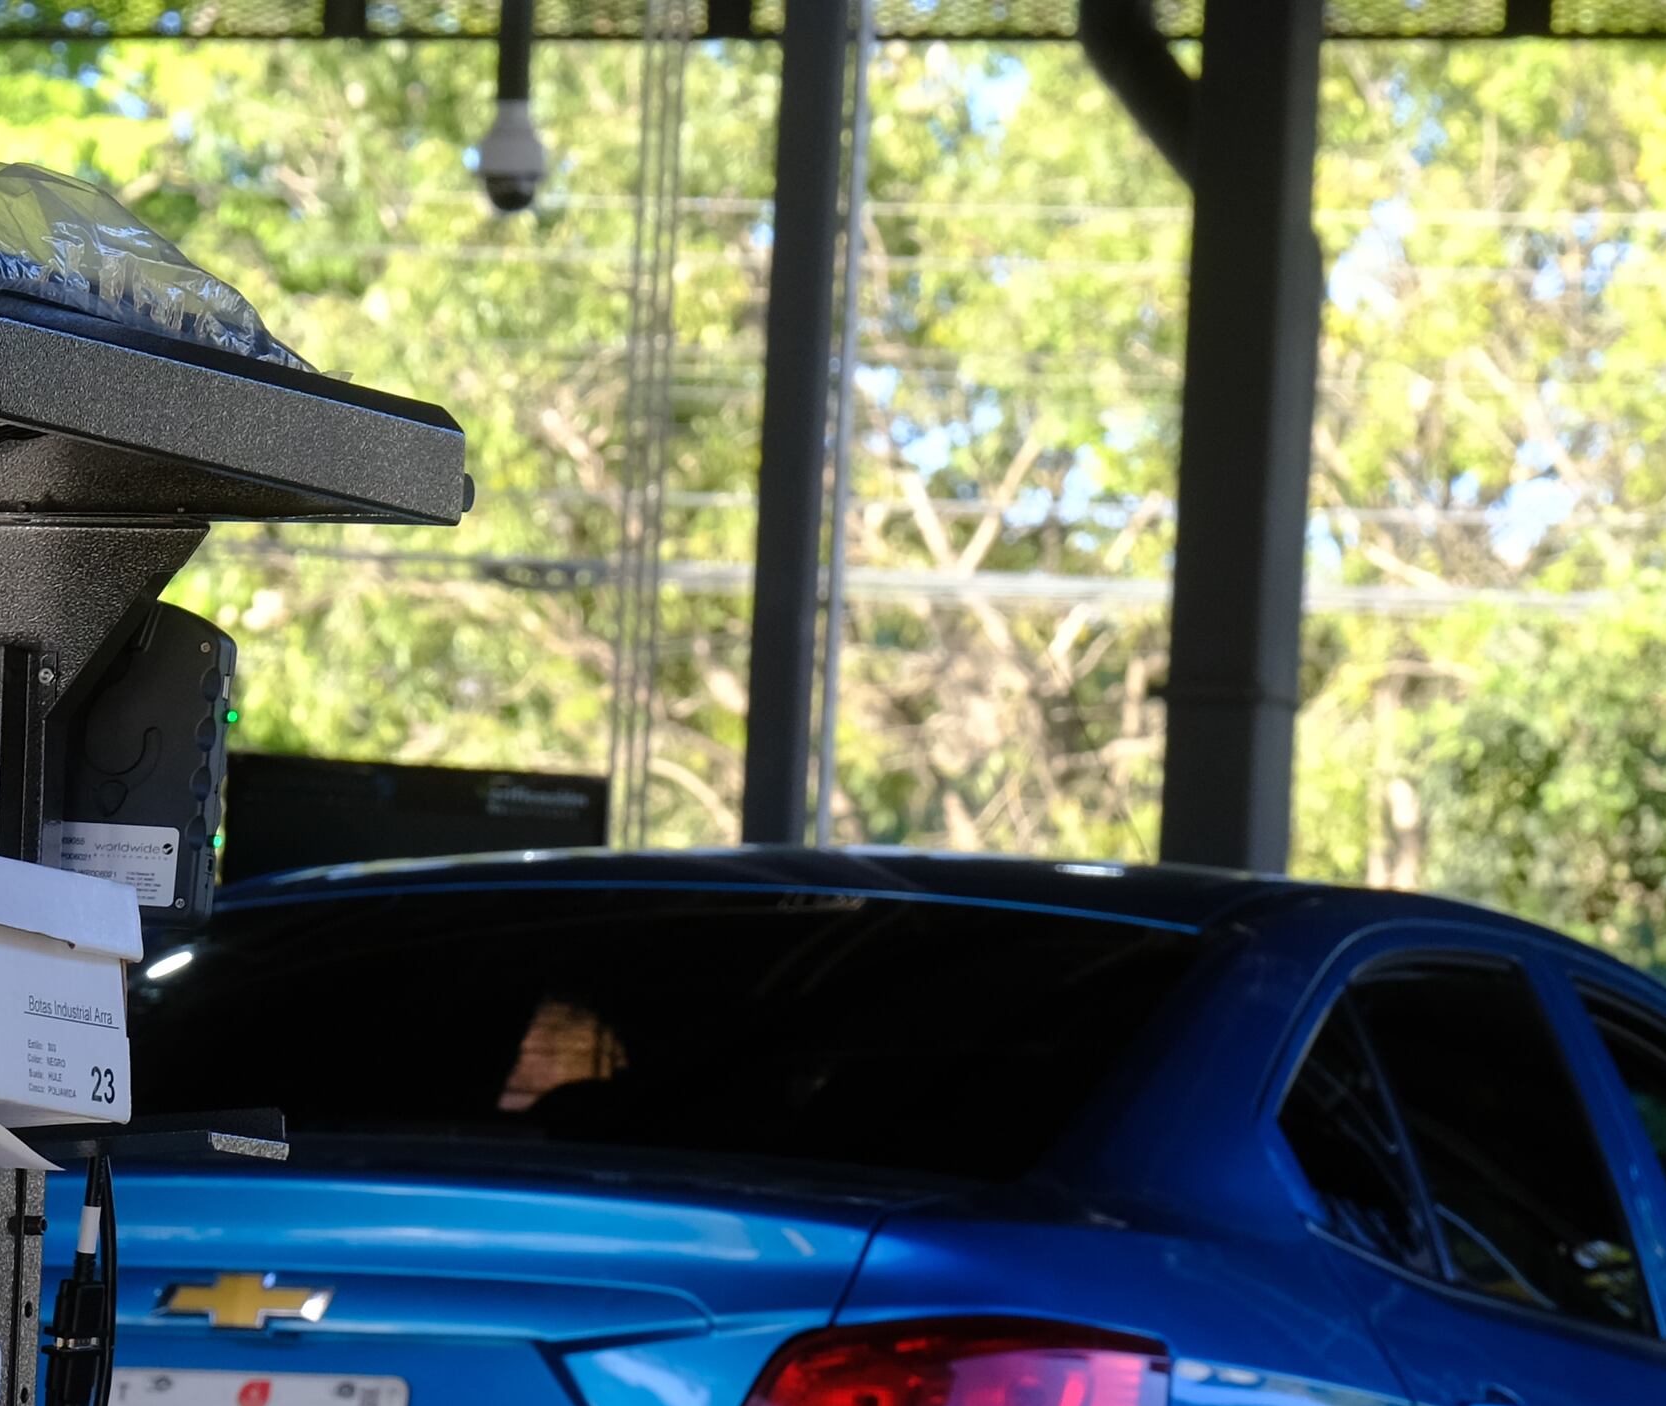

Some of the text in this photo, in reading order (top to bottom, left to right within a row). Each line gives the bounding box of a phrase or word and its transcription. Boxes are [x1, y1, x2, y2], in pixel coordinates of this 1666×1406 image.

[94, 841, 161, 855] worldwide
[28, 995, 113, 1024] Botas Industrial Arra
[47, 1057, 66, 1068] NEGRO
[48, 1072, 62, 1082] HULE
[91, 1066, 115, 1104] 23
